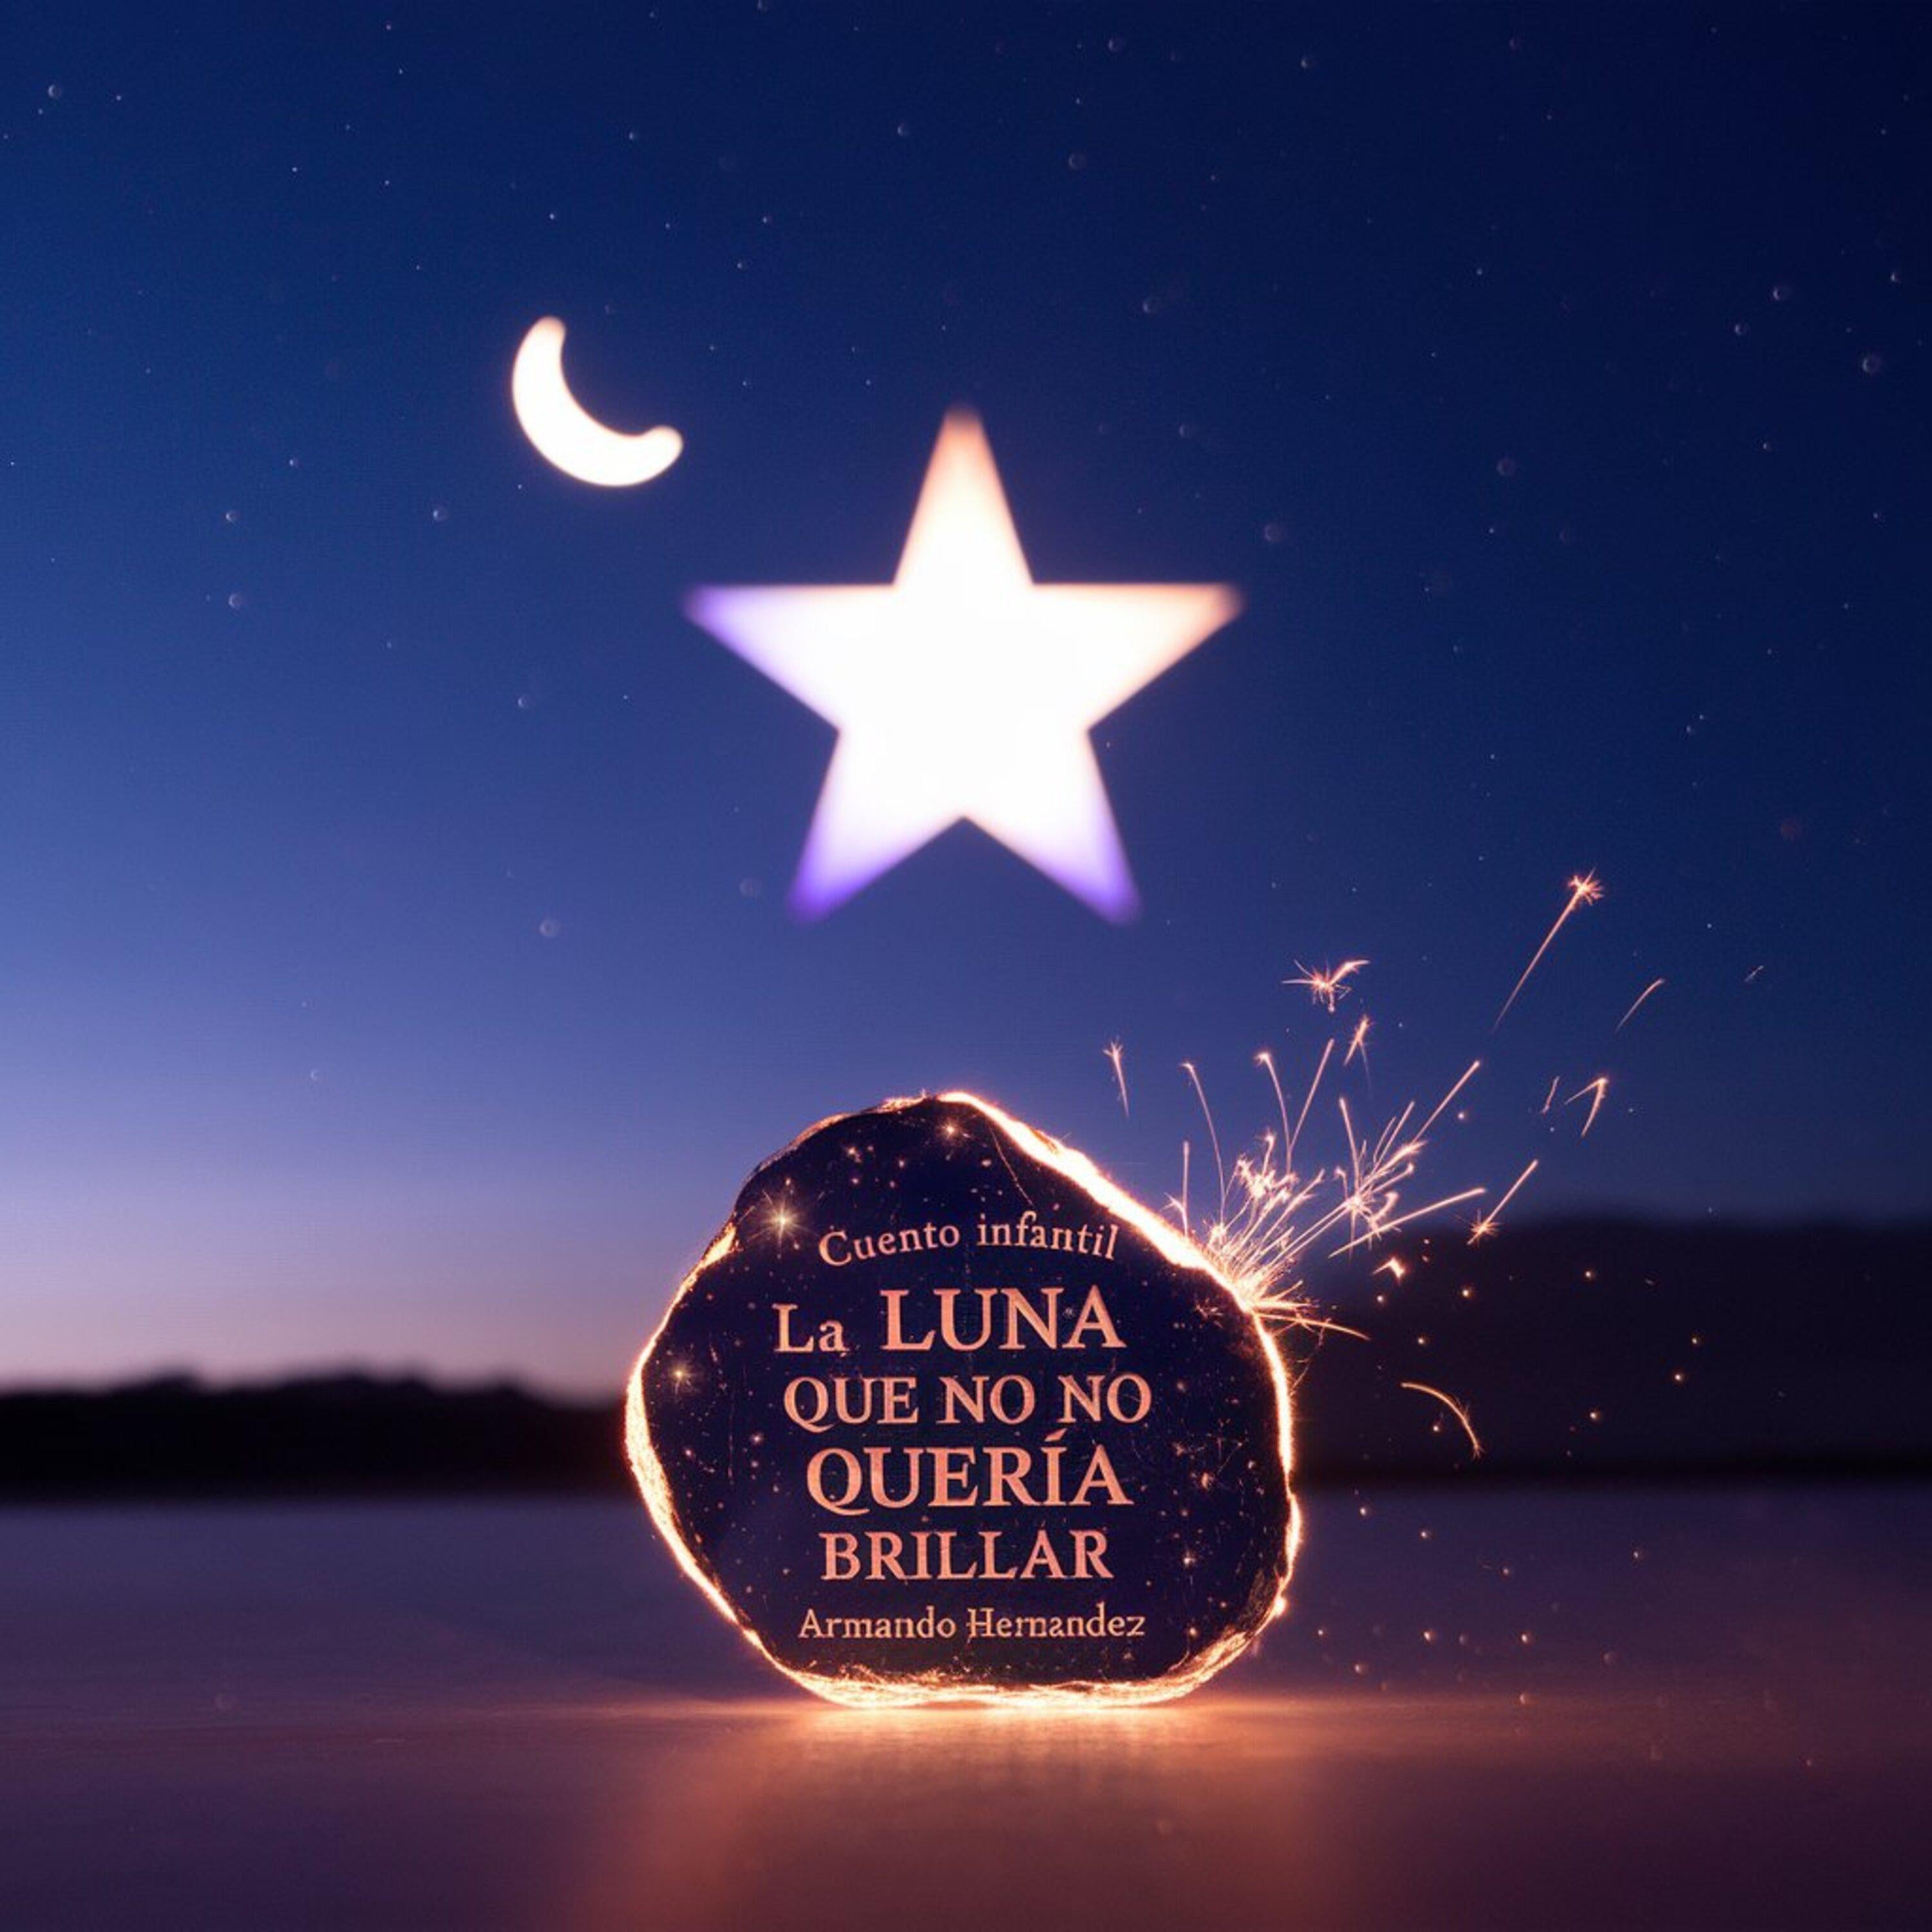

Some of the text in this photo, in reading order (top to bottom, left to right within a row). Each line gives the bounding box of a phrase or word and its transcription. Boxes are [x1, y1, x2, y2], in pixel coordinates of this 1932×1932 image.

[818, 1211, 1119, 1266] Cuento infantil
[772, 1284, 1127, 1356] La LUNA
[784, 1372, 1152, 1433] QUE NO NO
[806, 1427, 1134, 1515] QUERÍA
[819, 1529, 1114, 1580] BRILLAR
[799, 1605, 956, 1639] Armando
